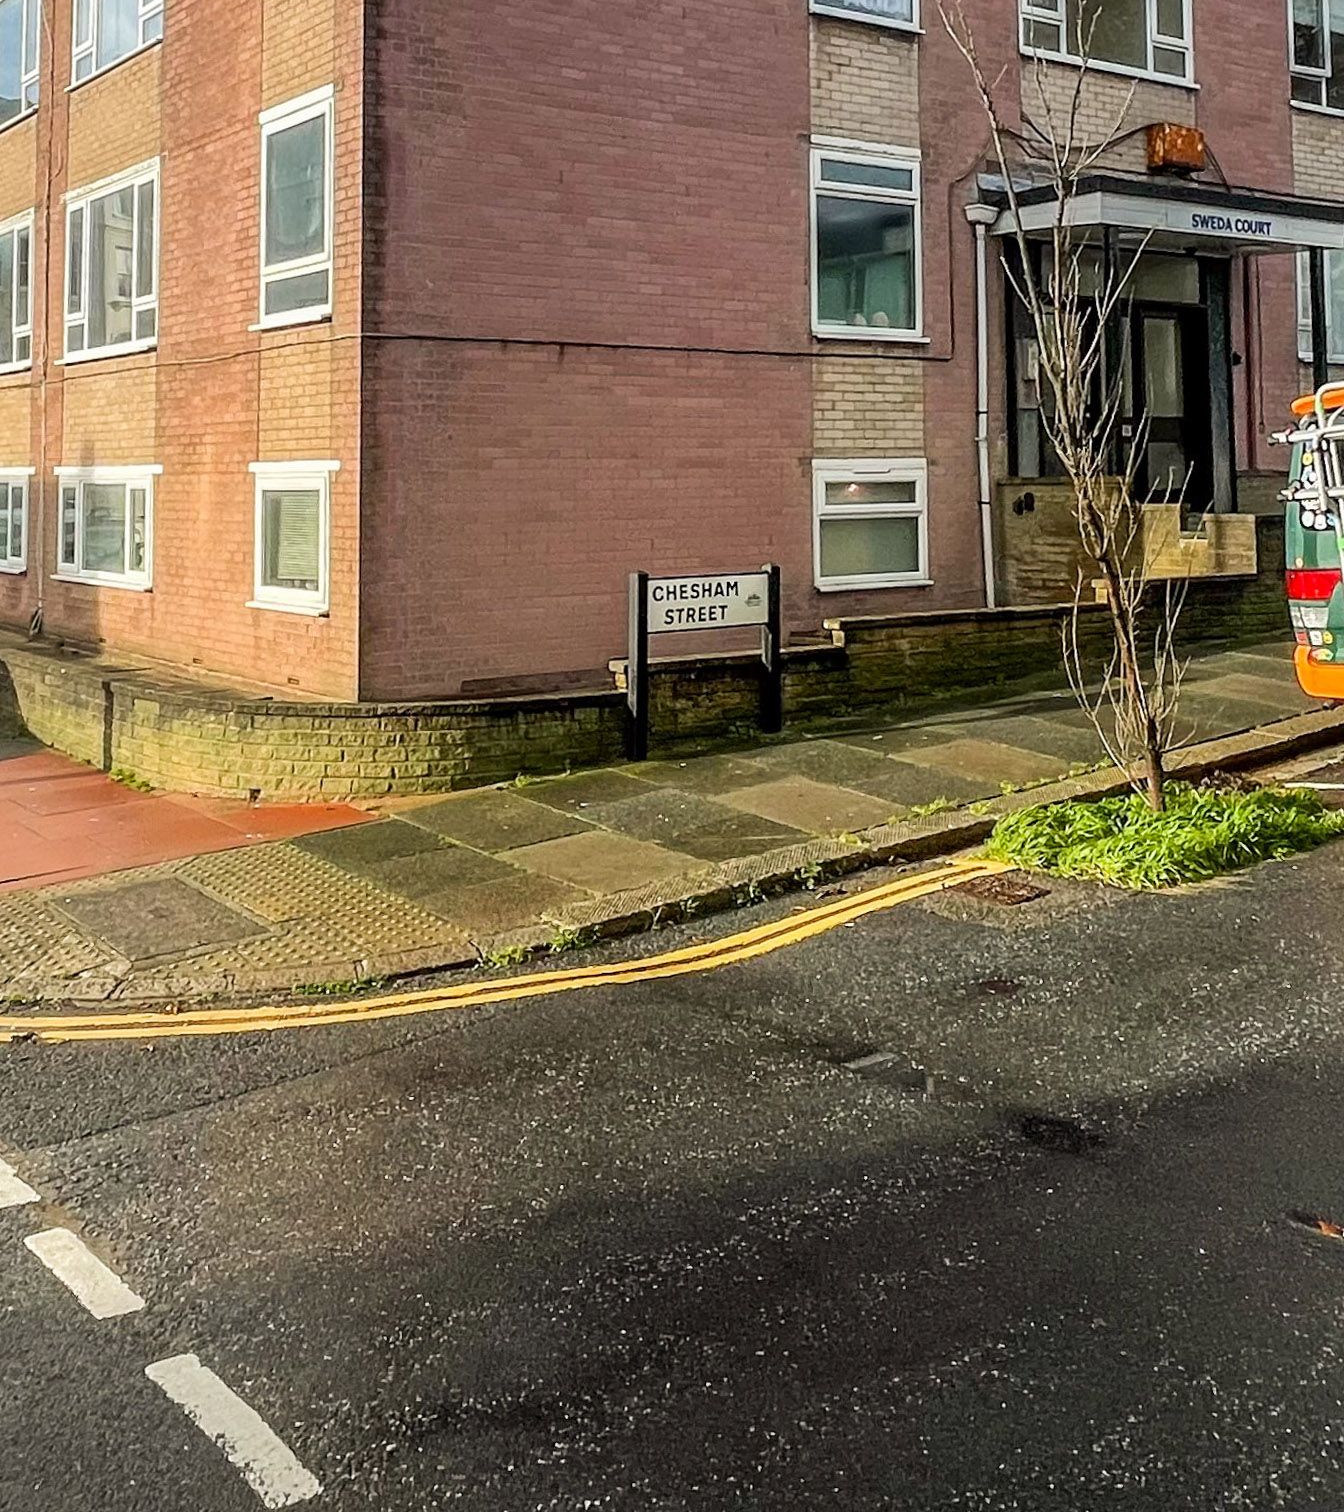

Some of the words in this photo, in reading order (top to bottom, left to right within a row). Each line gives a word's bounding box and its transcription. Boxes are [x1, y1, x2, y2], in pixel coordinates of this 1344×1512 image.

[1191, 213, 1233, 232] SWEDA
[1234, 218, 1272, 236] COURT
[652, 581, 739, 602] CHESHAM
[663, 605, 729, 625] STREET
